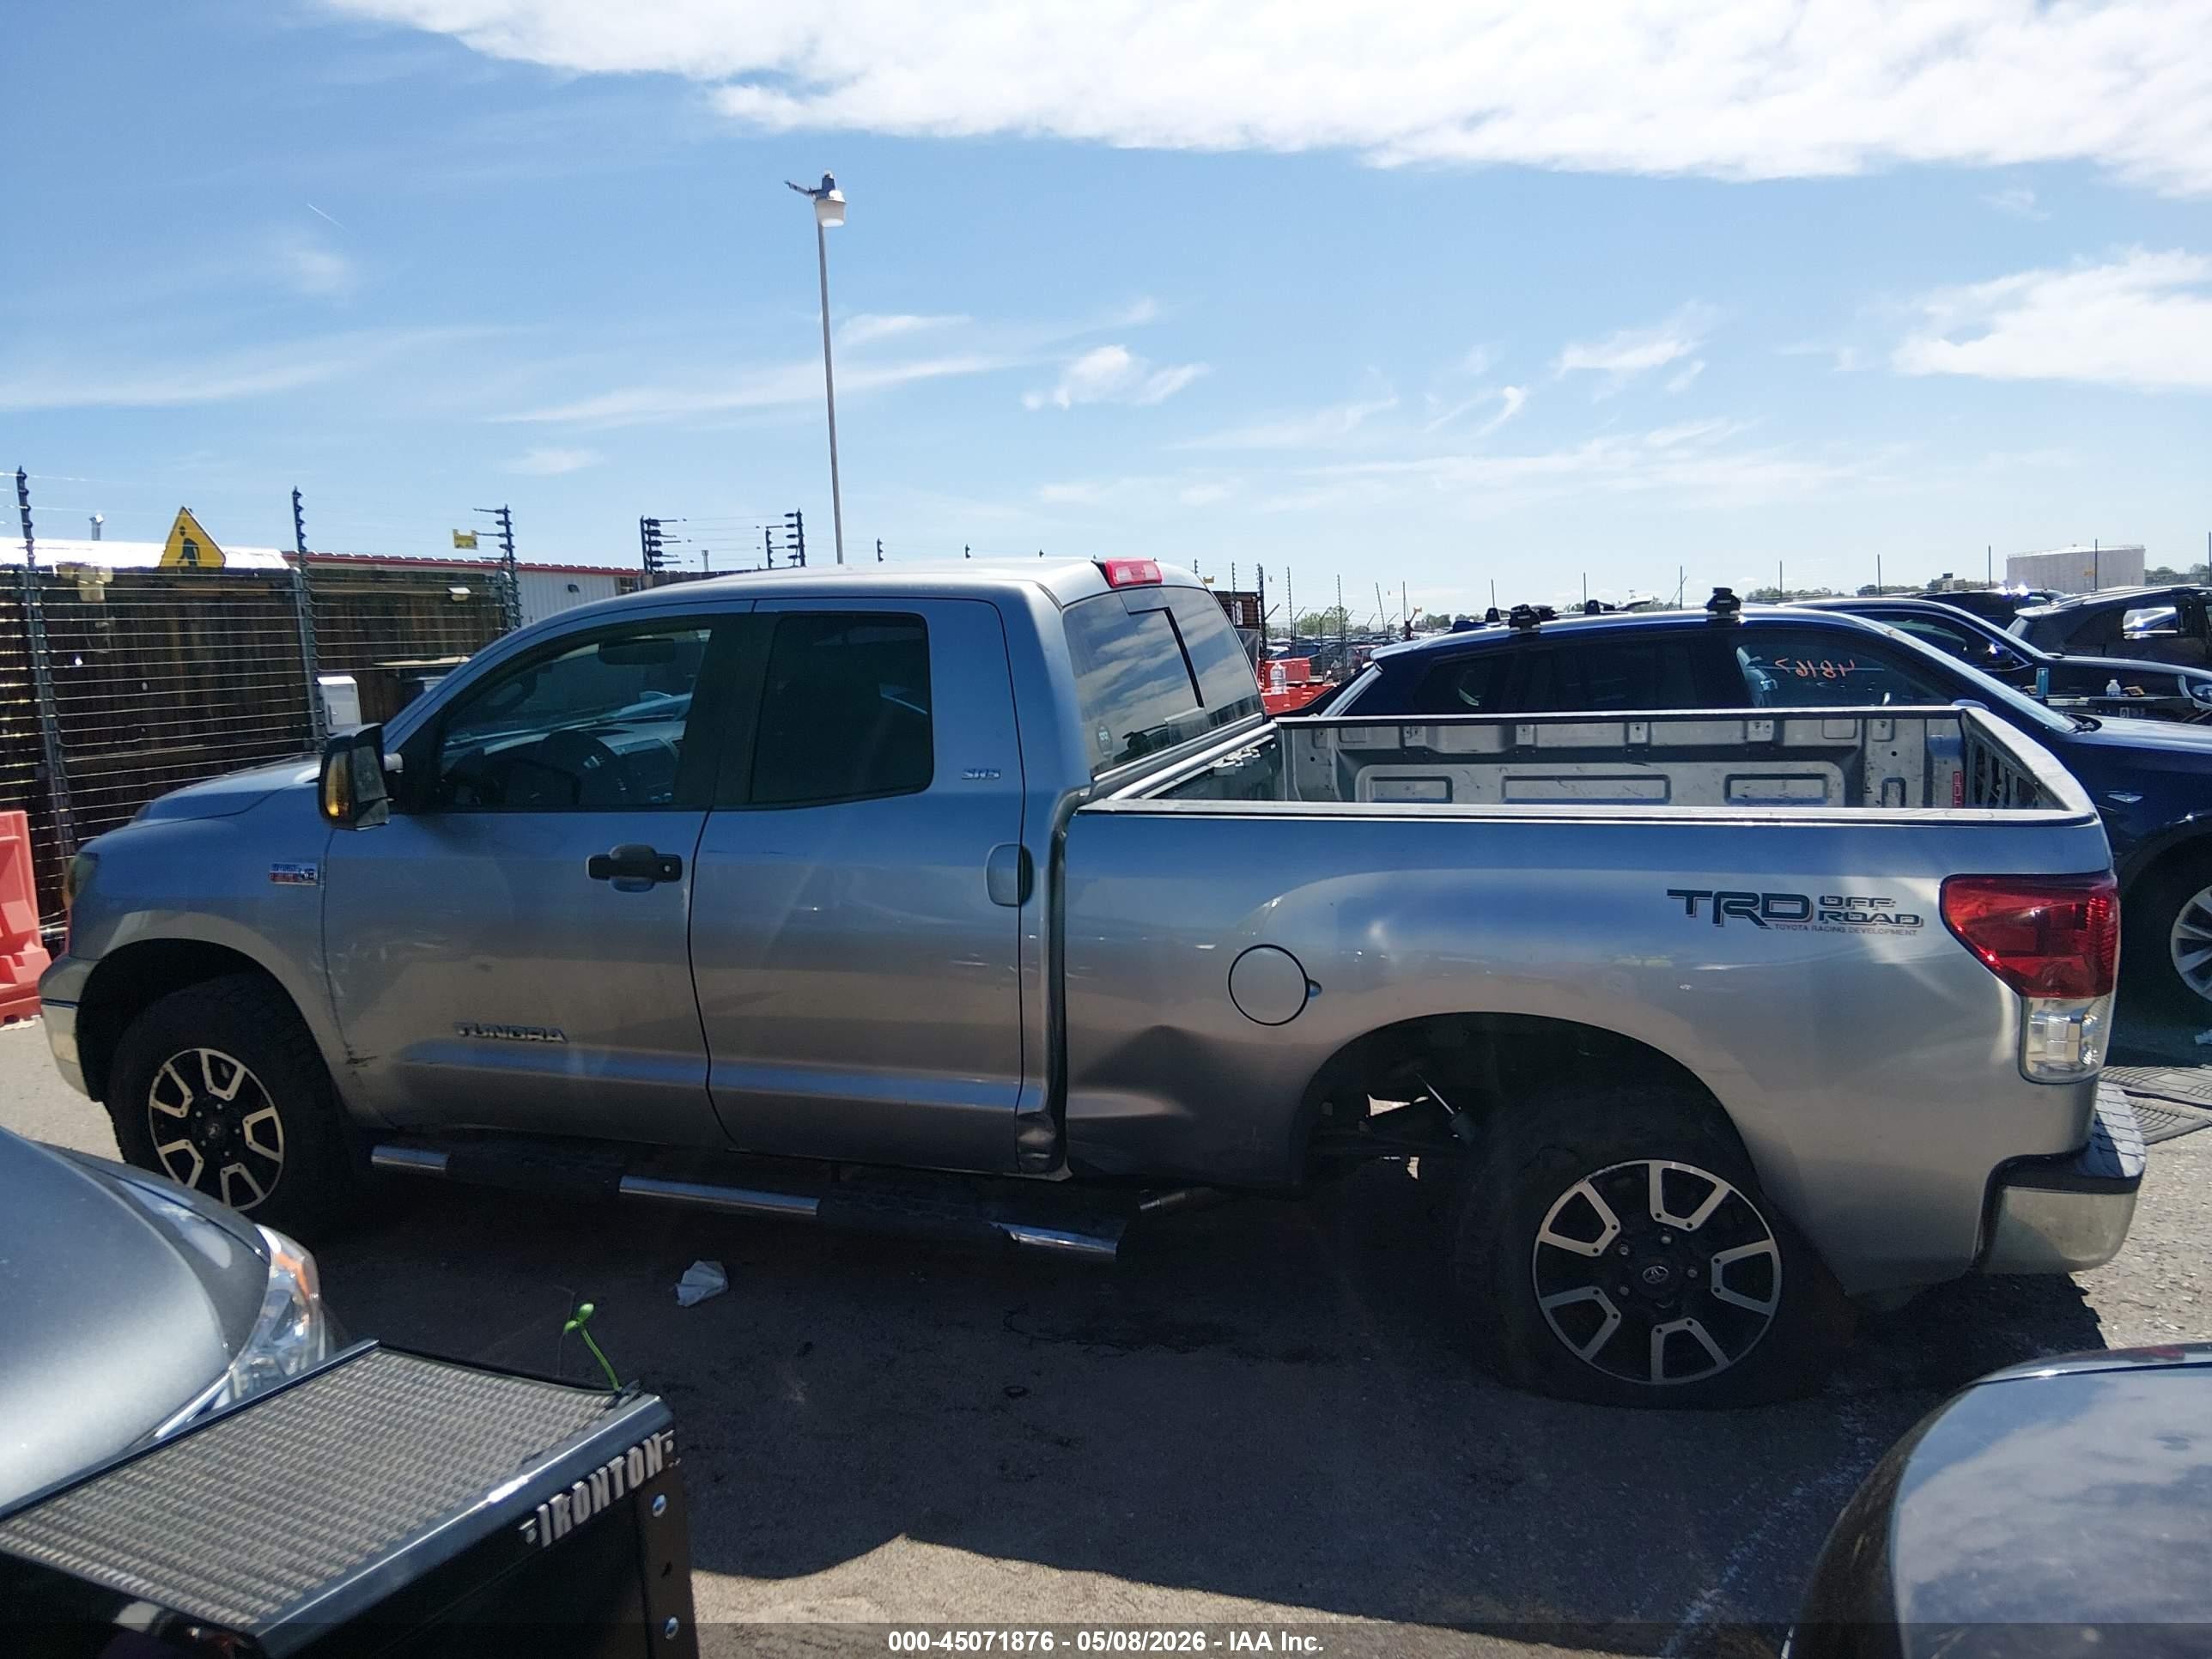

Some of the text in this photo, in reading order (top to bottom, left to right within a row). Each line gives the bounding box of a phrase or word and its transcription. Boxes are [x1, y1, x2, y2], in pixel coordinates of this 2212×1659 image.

[1667, 889, 1813, 929] TRD
[1819, 895, 1896, 910] OFF
[1818, 910, 1924, 928] ROAD
[1775, 923, 1917, 936] TOYOTA RACING DEVELOPMENT
[537, 1432, 663, 1547] IRONTON
